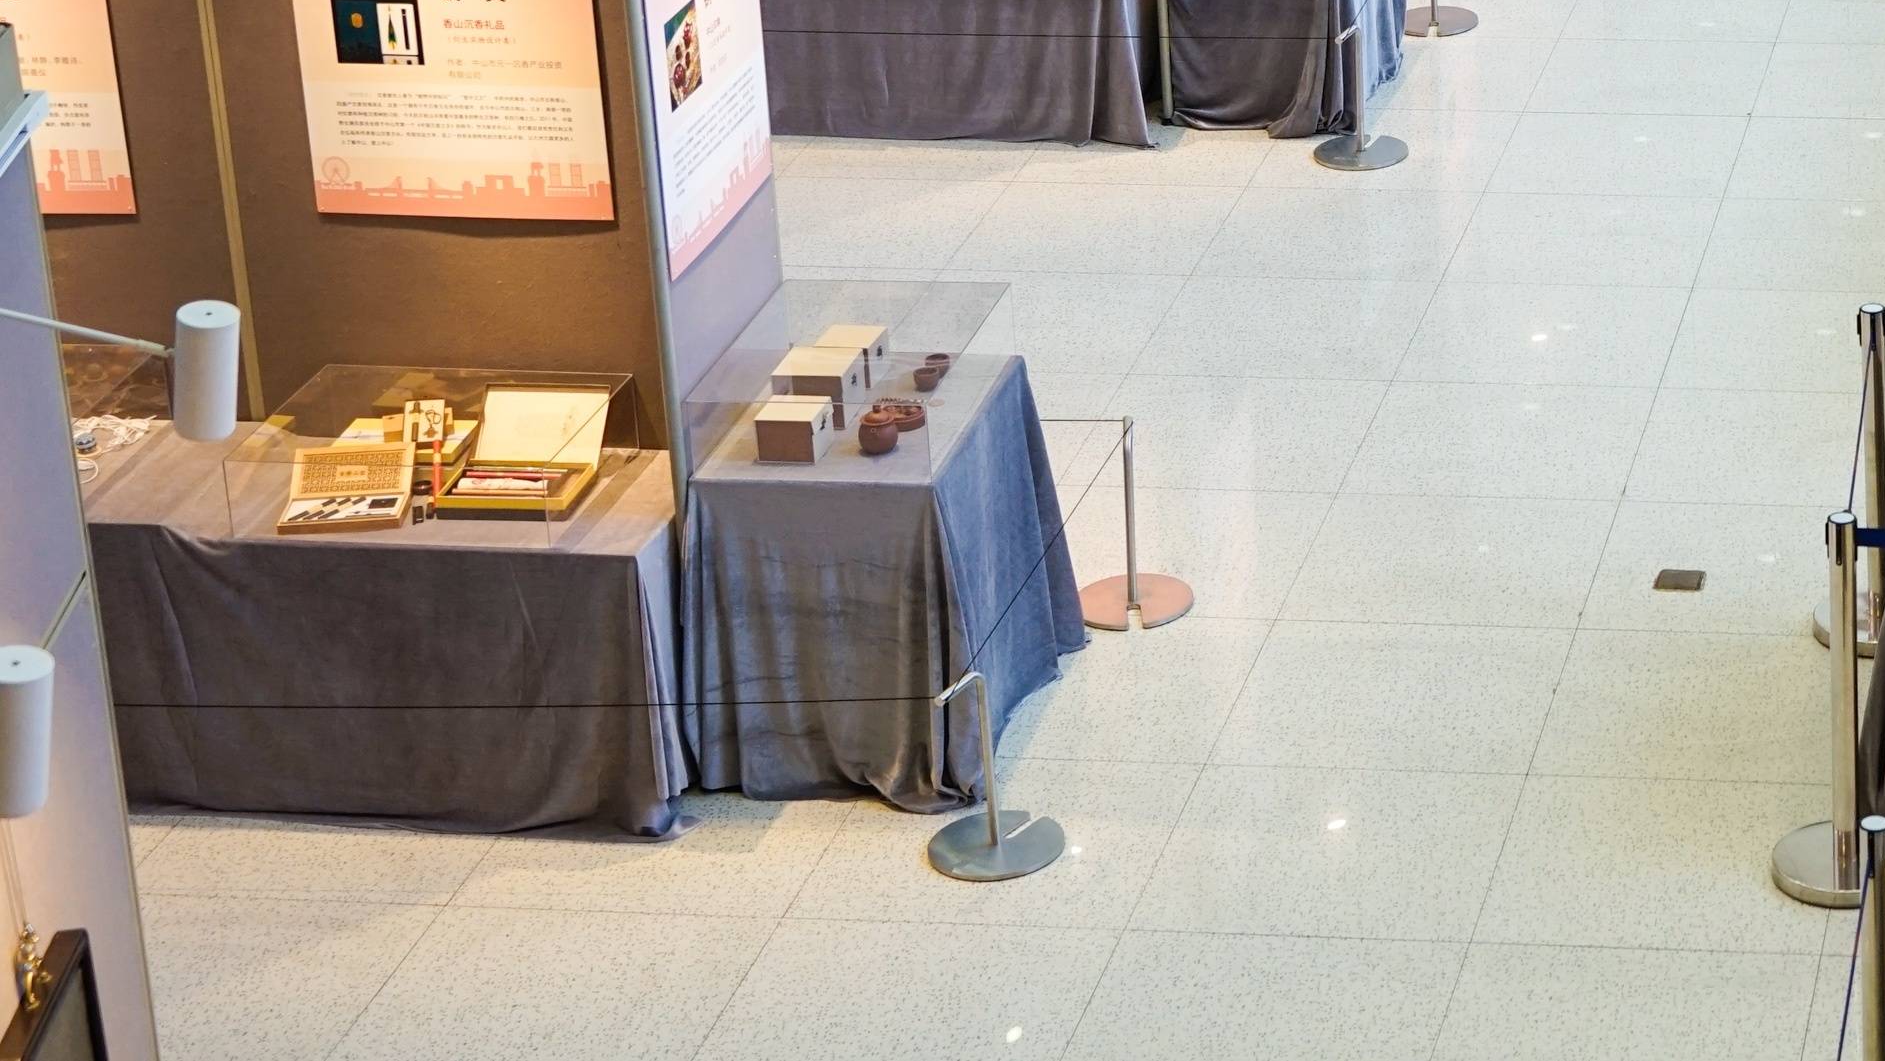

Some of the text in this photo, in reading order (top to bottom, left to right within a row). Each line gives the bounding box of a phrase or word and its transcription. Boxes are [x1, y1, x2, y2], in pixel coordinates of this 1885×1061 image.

[443, 18, 505, 31] 香山沉香礼品
